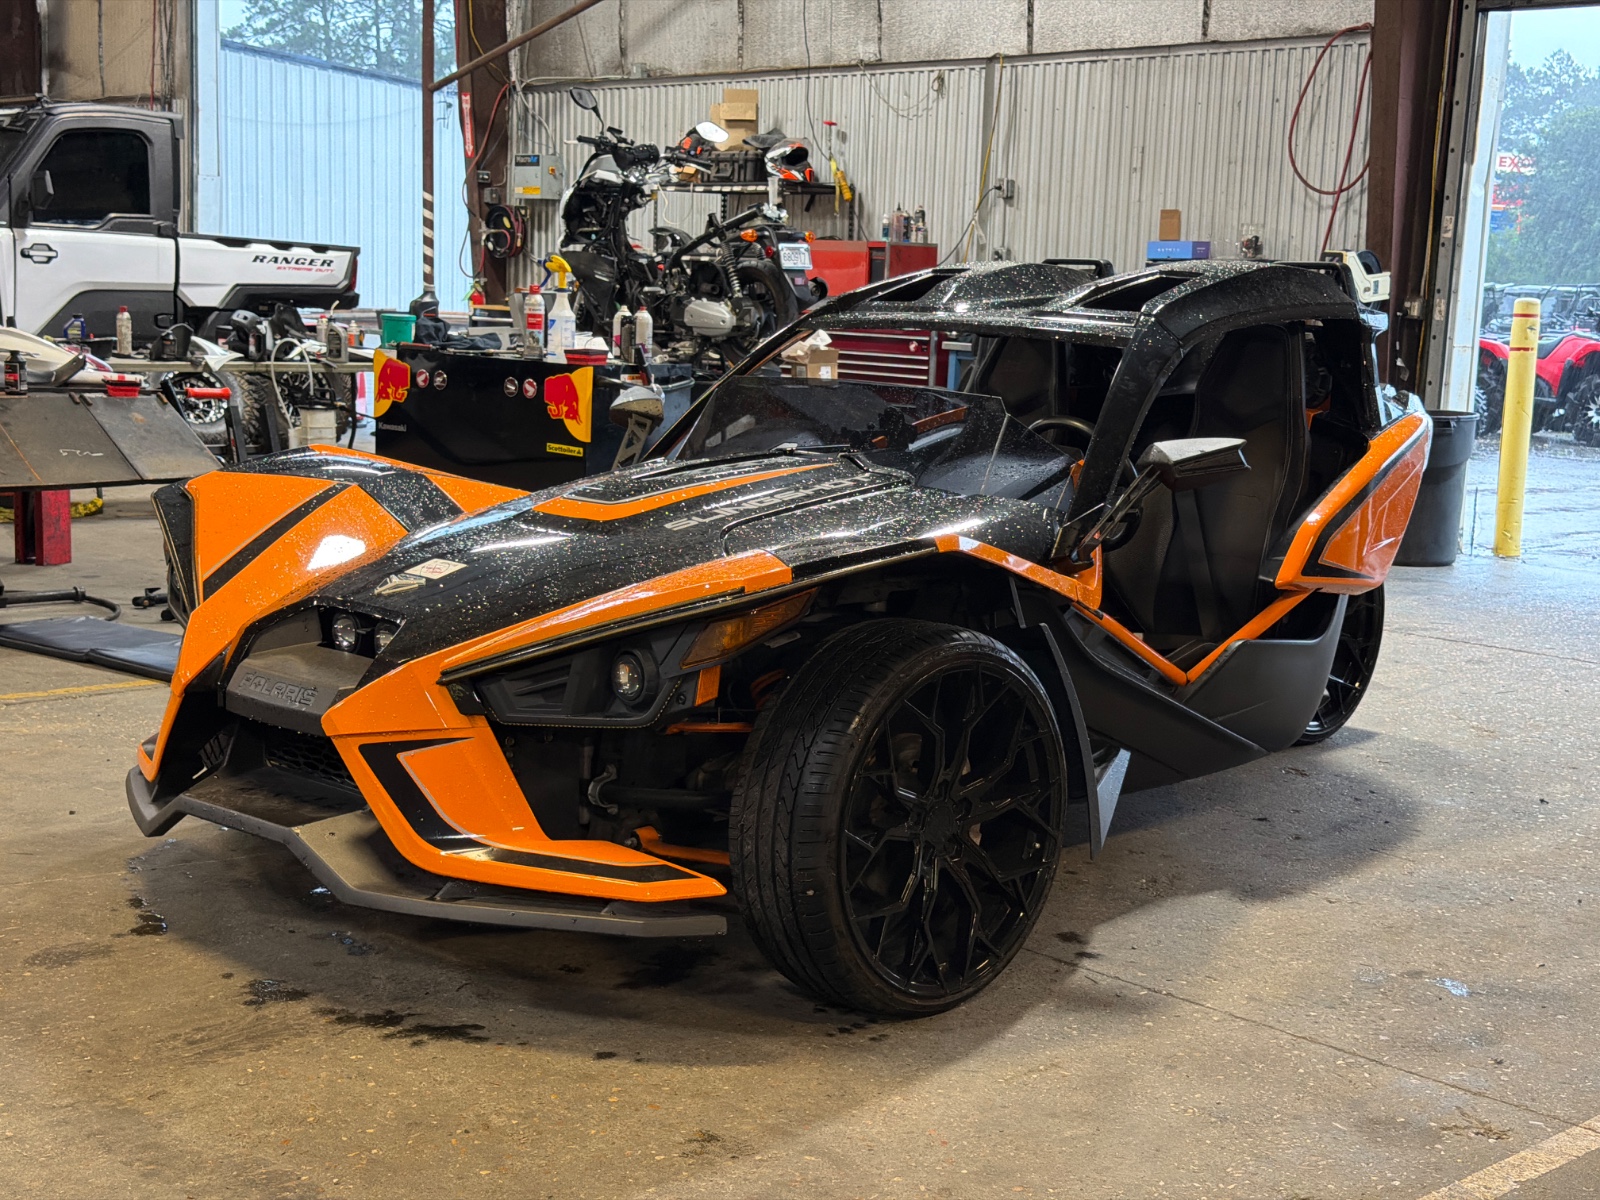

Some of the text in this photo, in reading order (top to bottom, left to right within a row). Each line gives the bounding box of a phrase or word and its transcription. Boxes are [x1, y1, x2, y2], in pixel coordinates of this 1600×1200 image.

[252, 255, 334, 267] RANGER
[547, 444, 576, 454] Scottoiler
[663, 473, 872, 531] SLINGSHOT
[239, 672, 319, 706] POLARIS
